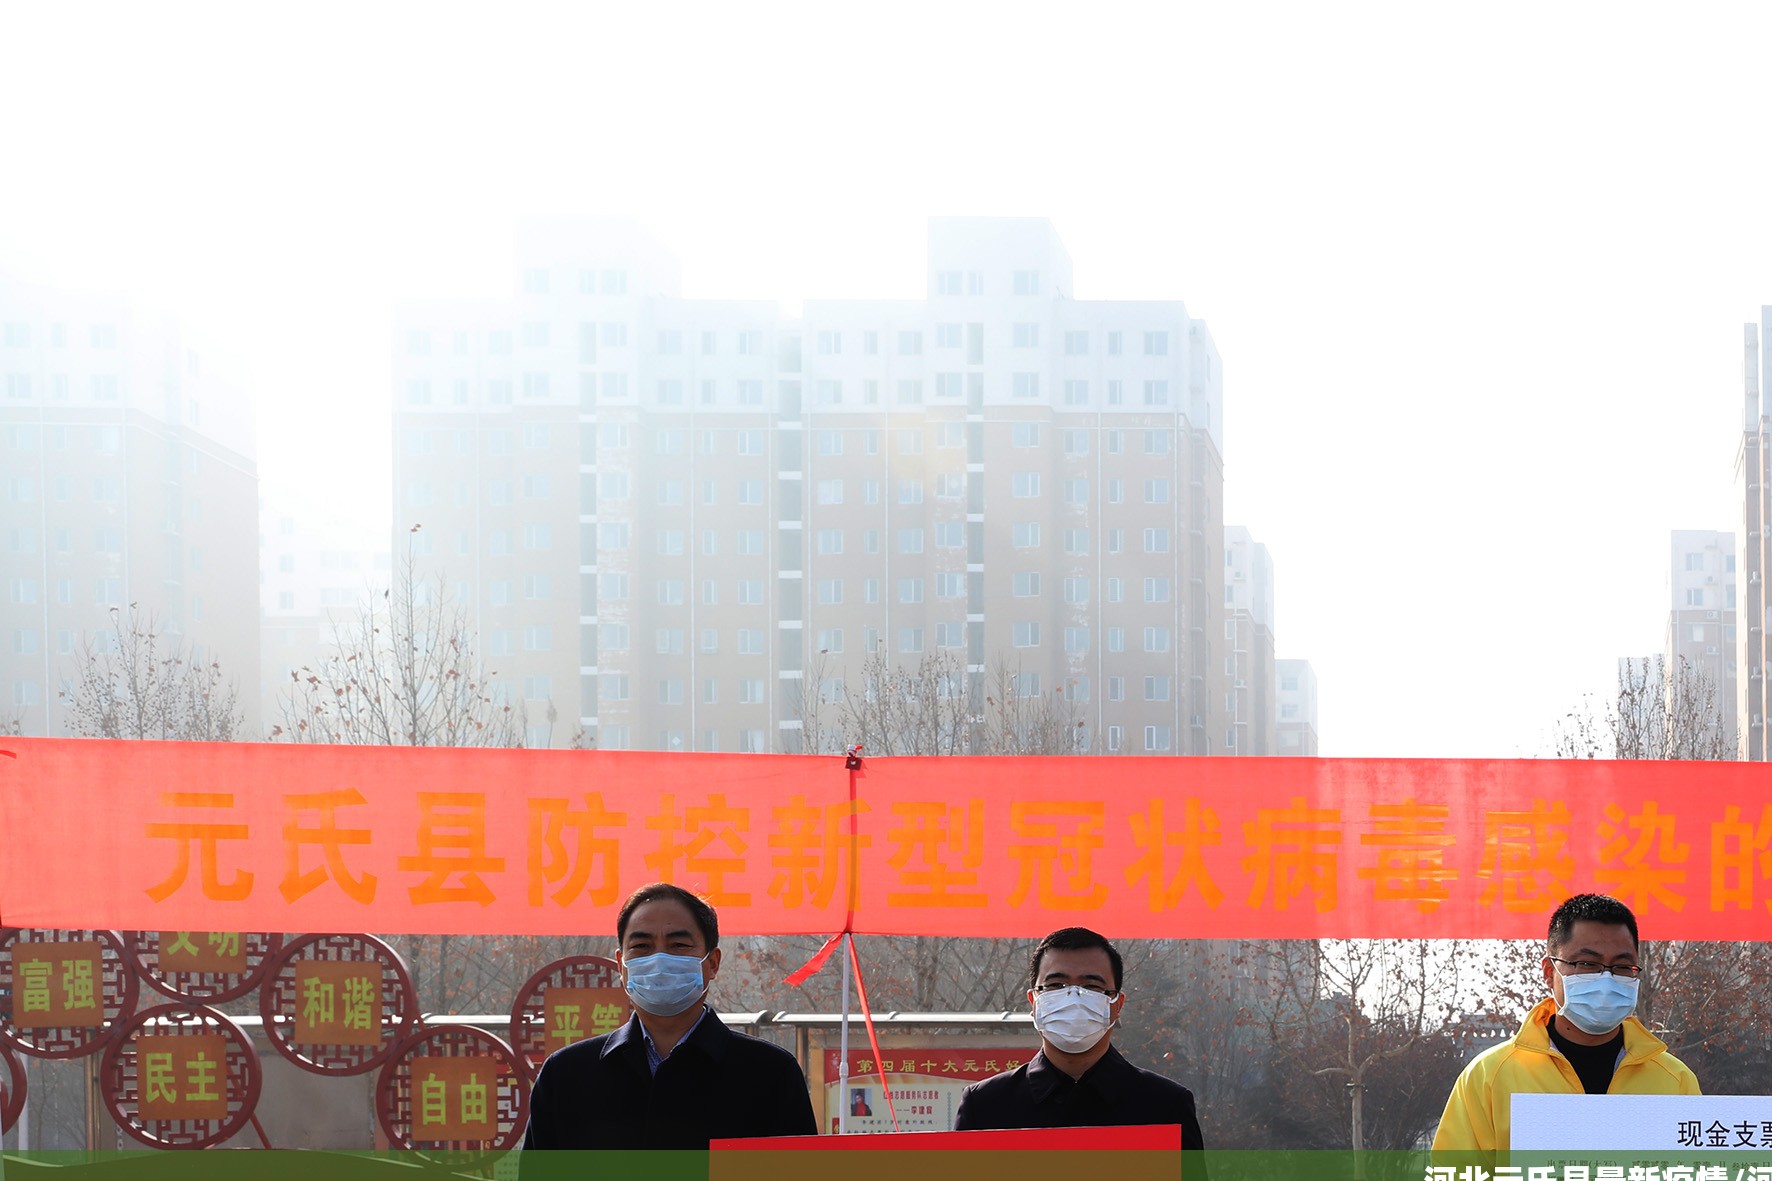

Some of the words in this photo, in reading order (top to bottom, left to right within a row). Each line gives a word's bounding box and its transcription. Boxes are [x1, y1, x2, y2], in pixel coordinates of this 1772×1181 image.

[19, 958, 96, 1012] 富强
[303, 976, 375, 1030] 和谐
[145, 1052, 219, 1104] 民主
[421, 1073, 487, 1125] 自由
